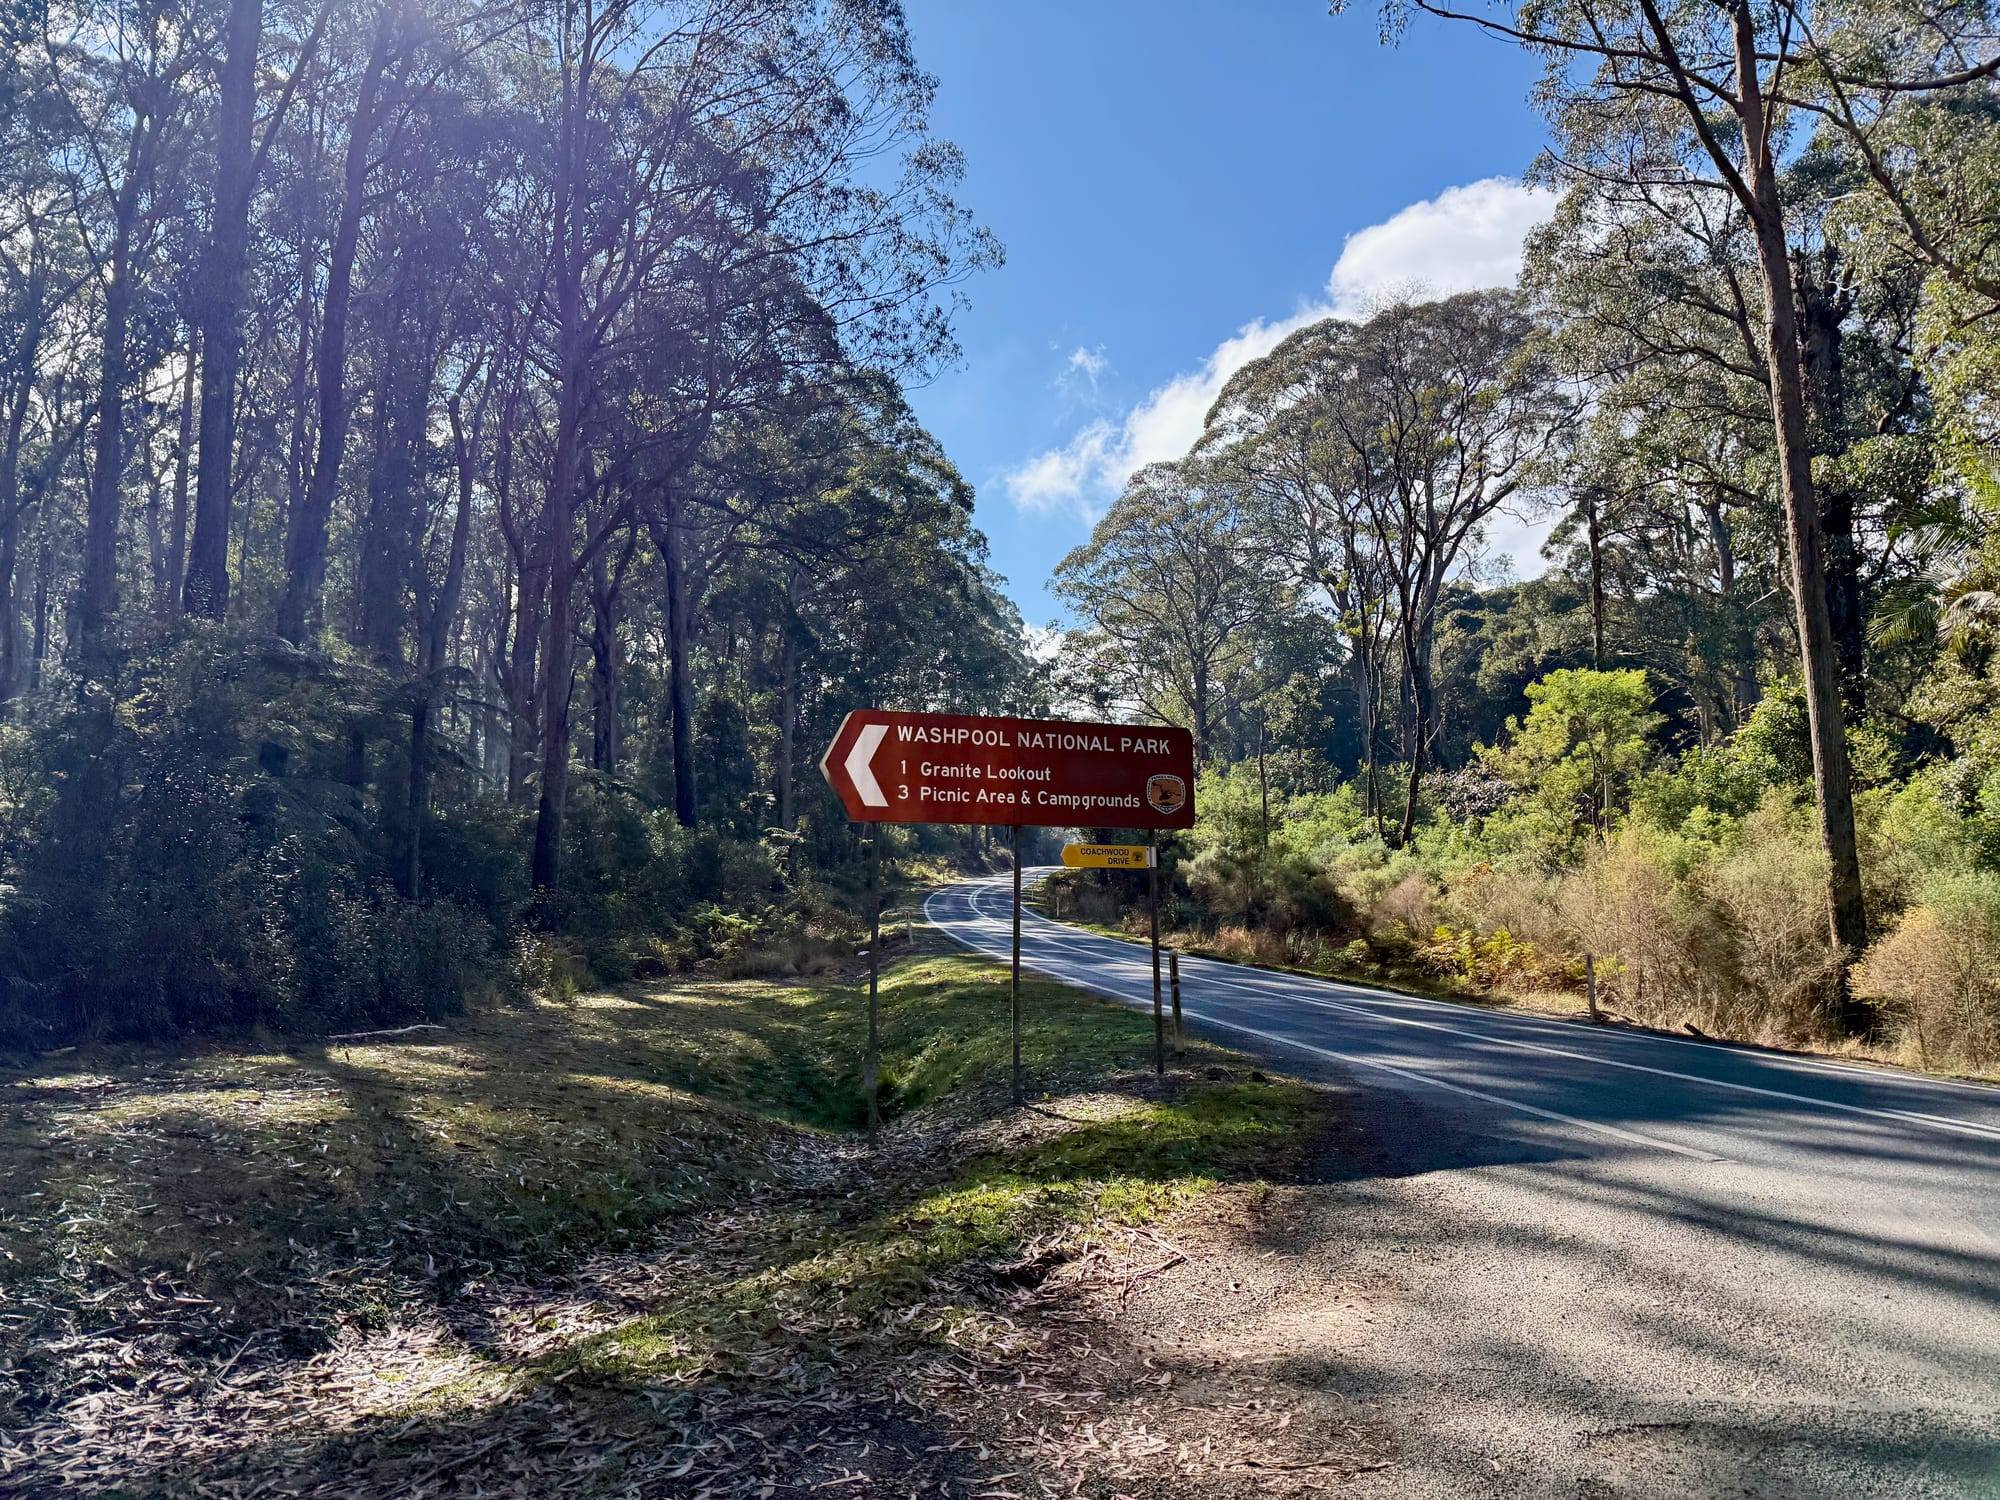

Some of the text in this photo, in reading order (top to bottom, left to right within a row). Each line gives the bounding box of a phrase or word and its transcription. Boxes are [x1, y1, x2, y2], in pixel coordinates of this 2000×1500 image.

[897, 725, 1171, 755] WASHPOOL NATIONAL PARK
[900, 759, 1051, 781] 1 Granite Lookout
[897, 784, 909, 800] 3
[920, 786, 970, 802] Picnic
[976, 788, 1016, 804] Area
[1020, 790, 1032, 805] &
[1037, 790, 1141, 810] Campgrounds
[1080, 847, 1130, 856] COACHWOOD
[1107, 857, 1130, 865] DRIVE
